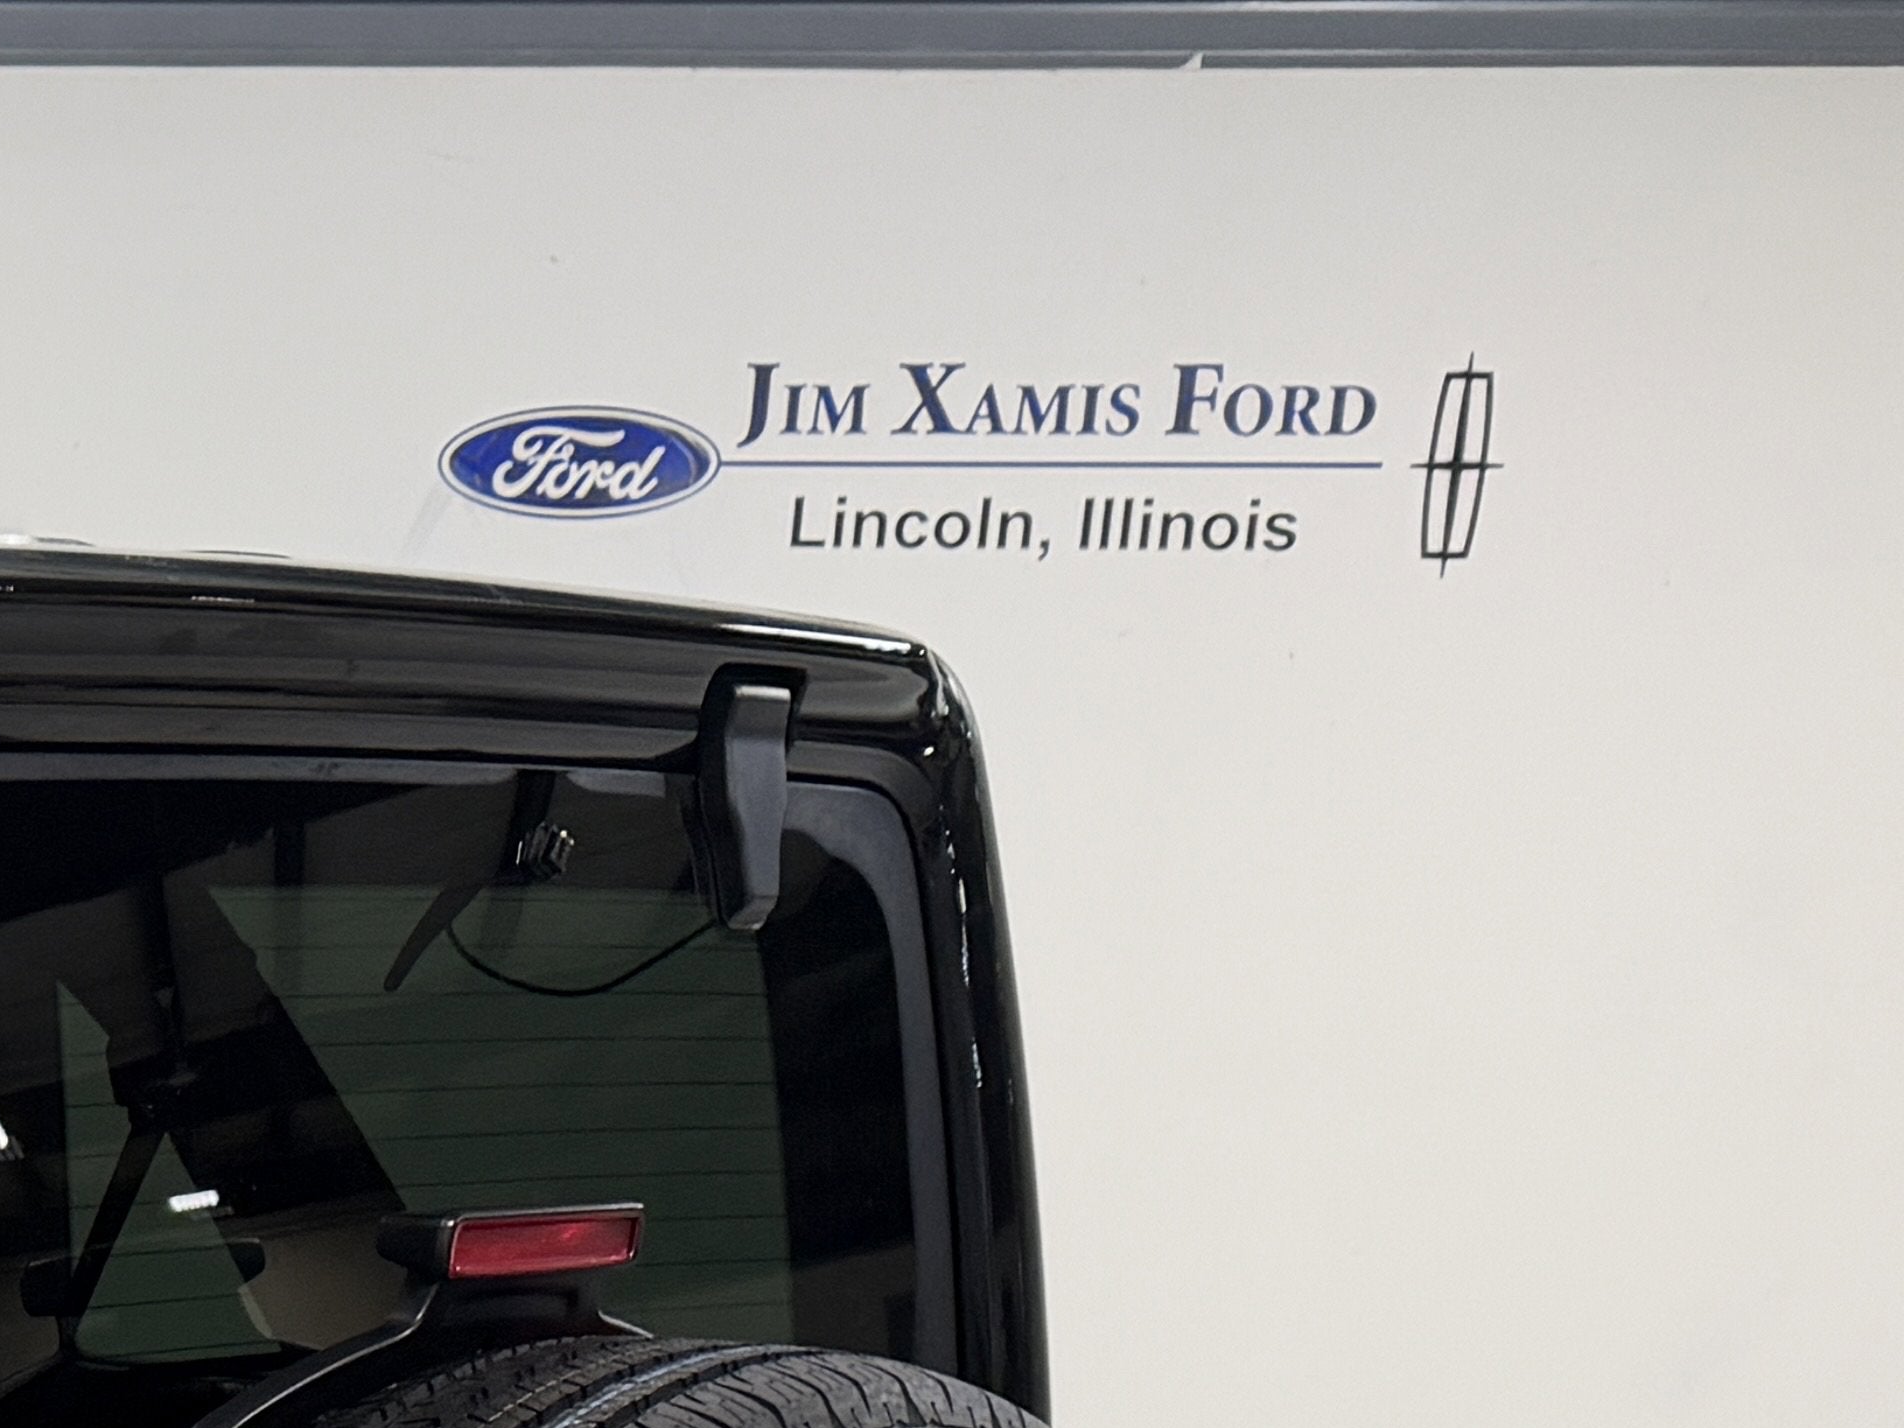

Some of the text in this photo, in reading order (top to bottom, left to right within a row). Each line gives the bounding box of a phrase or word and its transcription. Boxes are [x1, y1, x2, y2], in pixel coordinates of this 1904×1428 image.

[736, 361, 1378, 449] JIM XAMIS FORD
[489, 424, 662, 504] Ford
[789, 494, 1298, 562] Lincoln, Illinois
